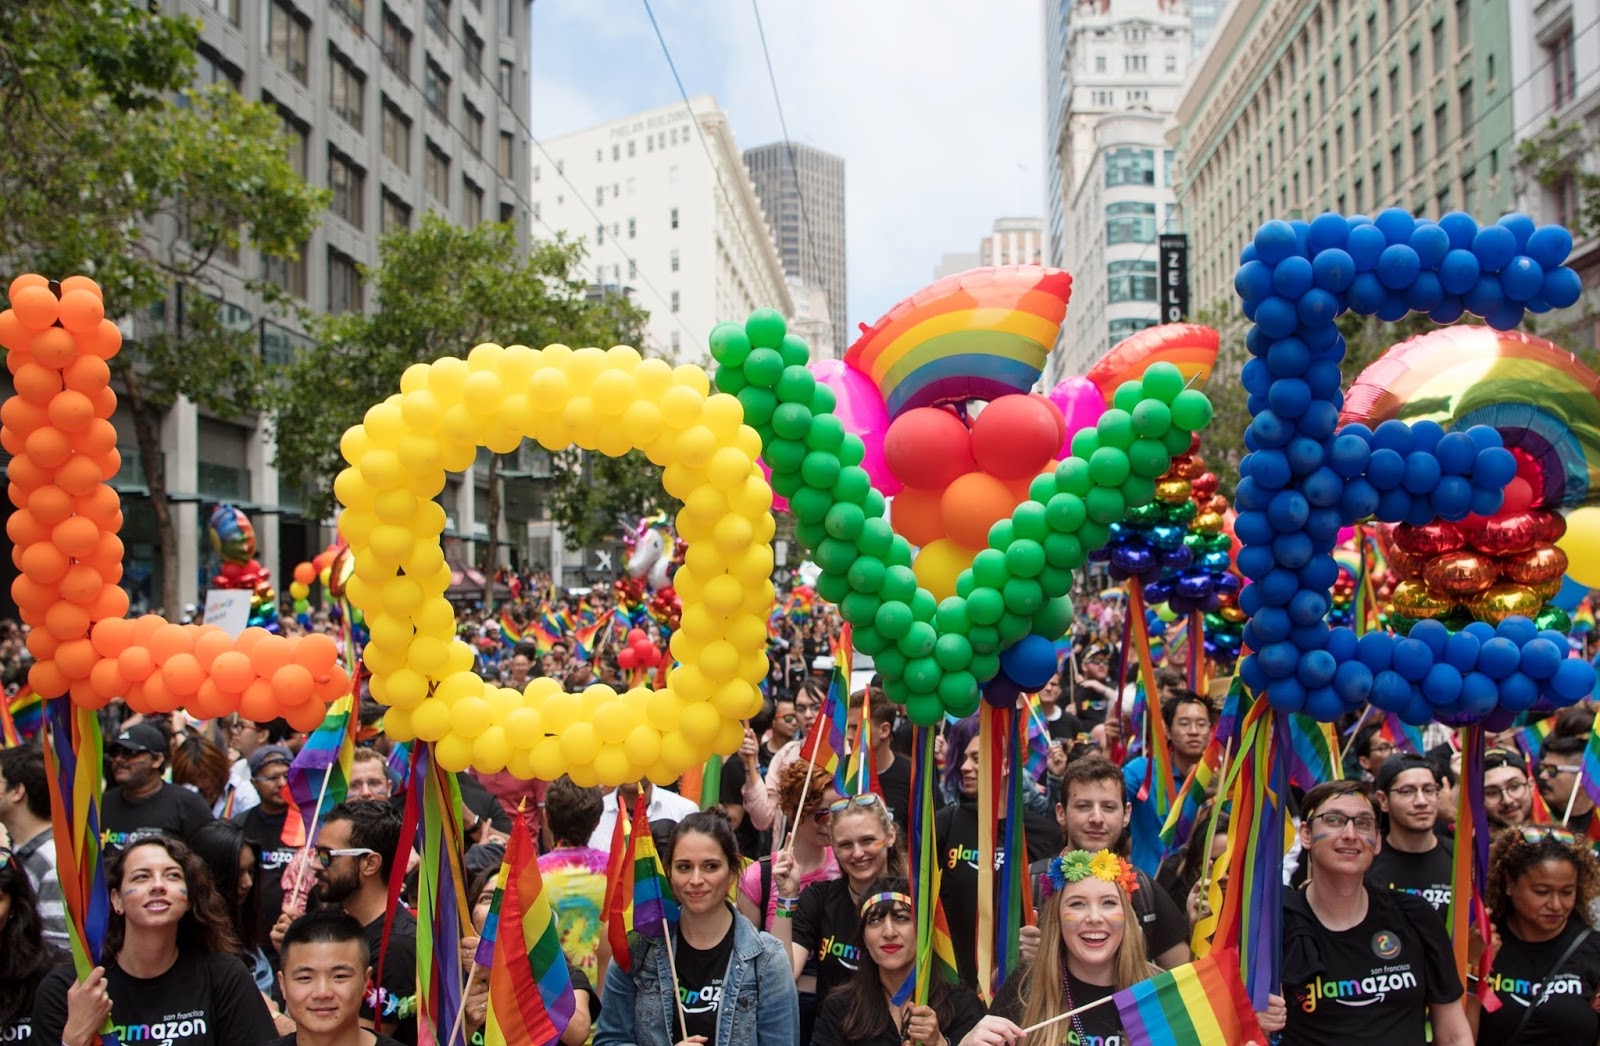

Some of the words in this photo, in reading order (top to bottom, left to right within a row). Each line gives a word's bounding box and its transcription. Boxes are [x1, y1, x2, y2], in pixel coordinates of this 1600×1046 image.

[1370, 967, 1383, 976] san
[1383, 963, 1411, 974] francisco
[1301, 971, 1417, 1013] glamazon
[162, 1013, 176, 1022] san
[176, 1010, 204, 1020] francisco
[111, 1018, 207, 1042] amazon
